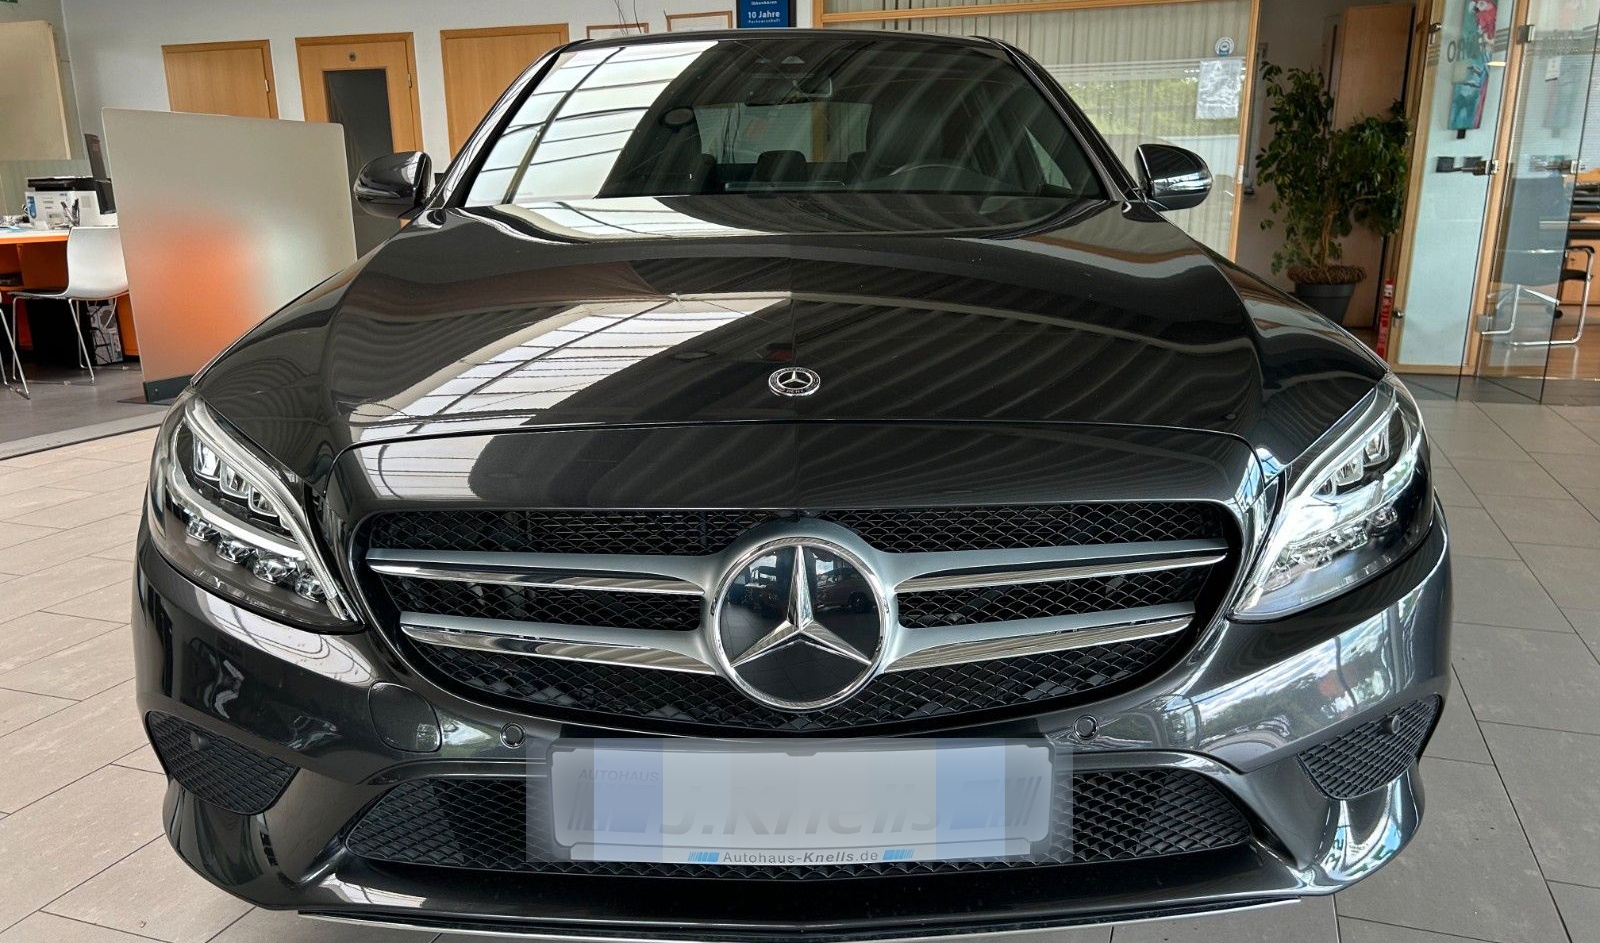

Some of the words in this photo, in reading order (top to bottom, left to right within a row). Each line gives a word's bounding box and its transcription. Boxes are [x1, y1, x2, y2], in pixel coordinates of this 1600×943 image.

[758, 10, 780, 18] Jahre
[577, 769, 659, 782] AUTOHAUS
[723, 851, 878, 864] Autohaus-Knells.de
